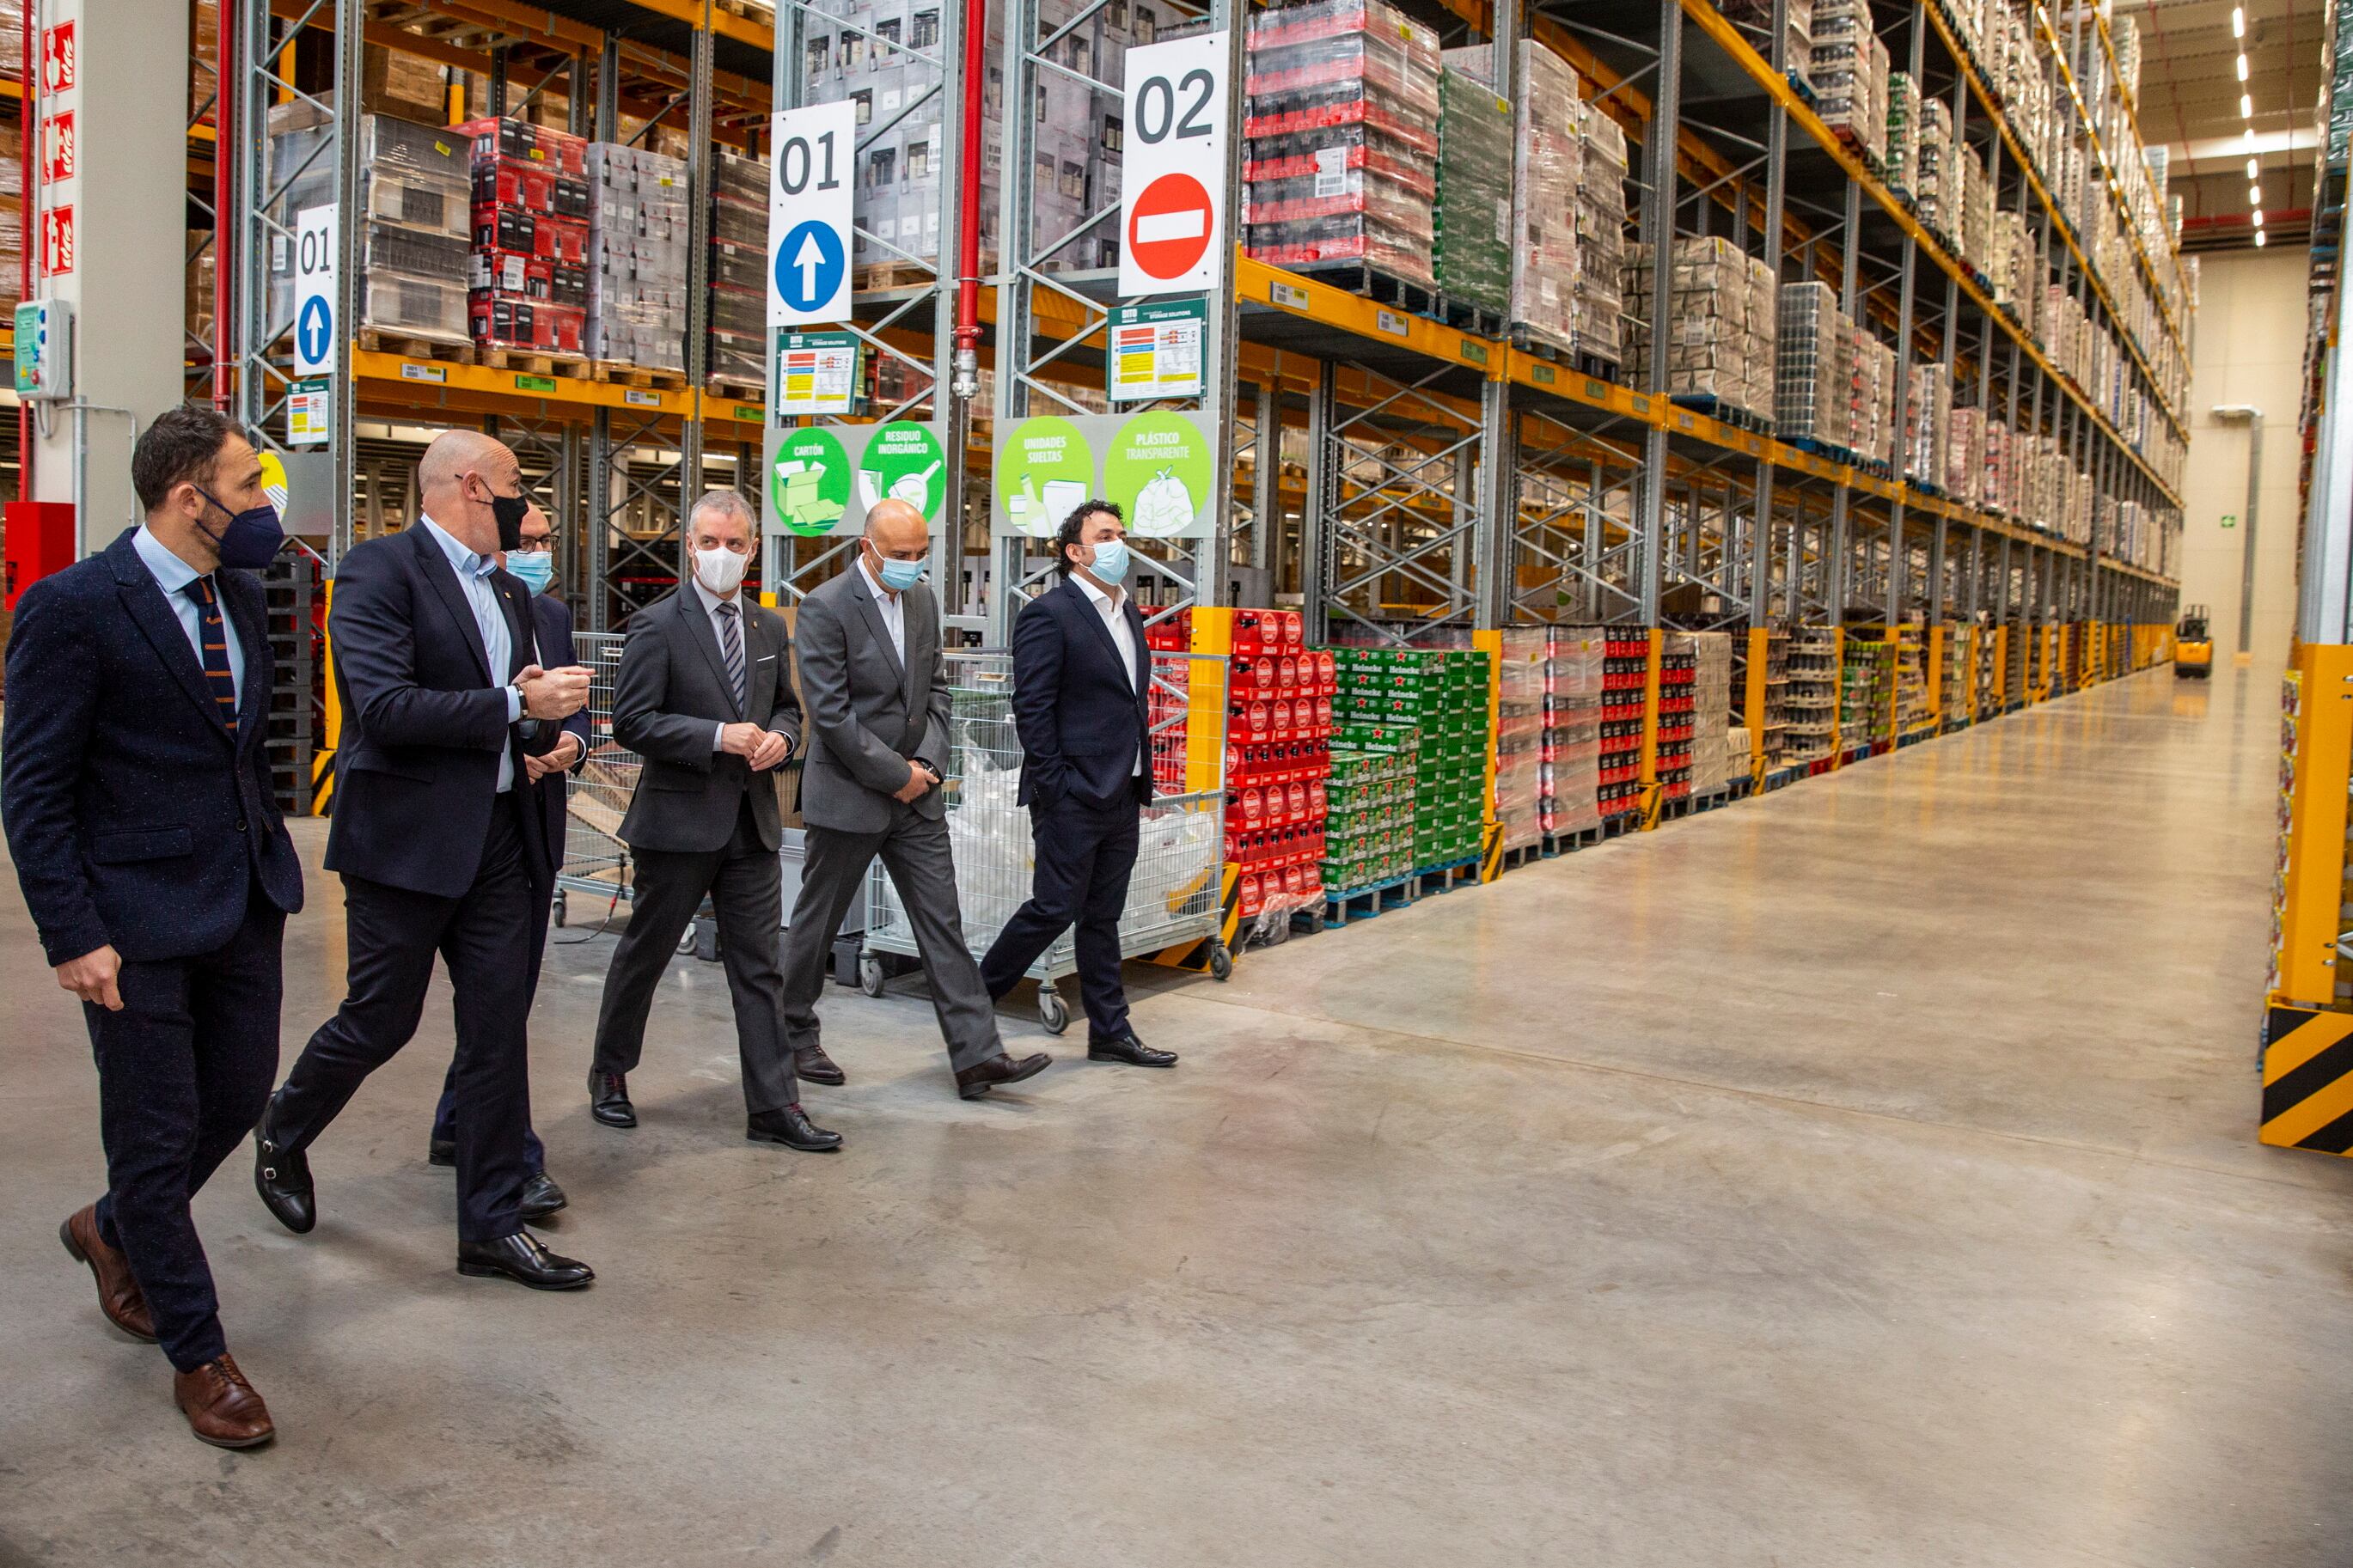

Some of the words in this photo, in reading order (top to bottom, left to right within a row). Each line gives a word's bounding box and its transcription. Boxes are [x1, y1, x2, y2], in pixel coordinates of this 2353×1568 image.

[1135, 69, 1214, 144] 02
[780, 131, 839, 196] 01
[302, 227, 330, 275] 01
[885, 430, 921, 442] RESIDUO
[1024, 436, 1066, 449] UNIDADES
[1135, 431, 1180, 446] PLÁSTICO
[794, 443, 824, 456] CARTÓN
[878, 442, 928, 455] INORGÁNICO
[1126, 446, 1189, 460] TRANSPARENTE
[1027, 450, 1062, 464] SUELTAS
